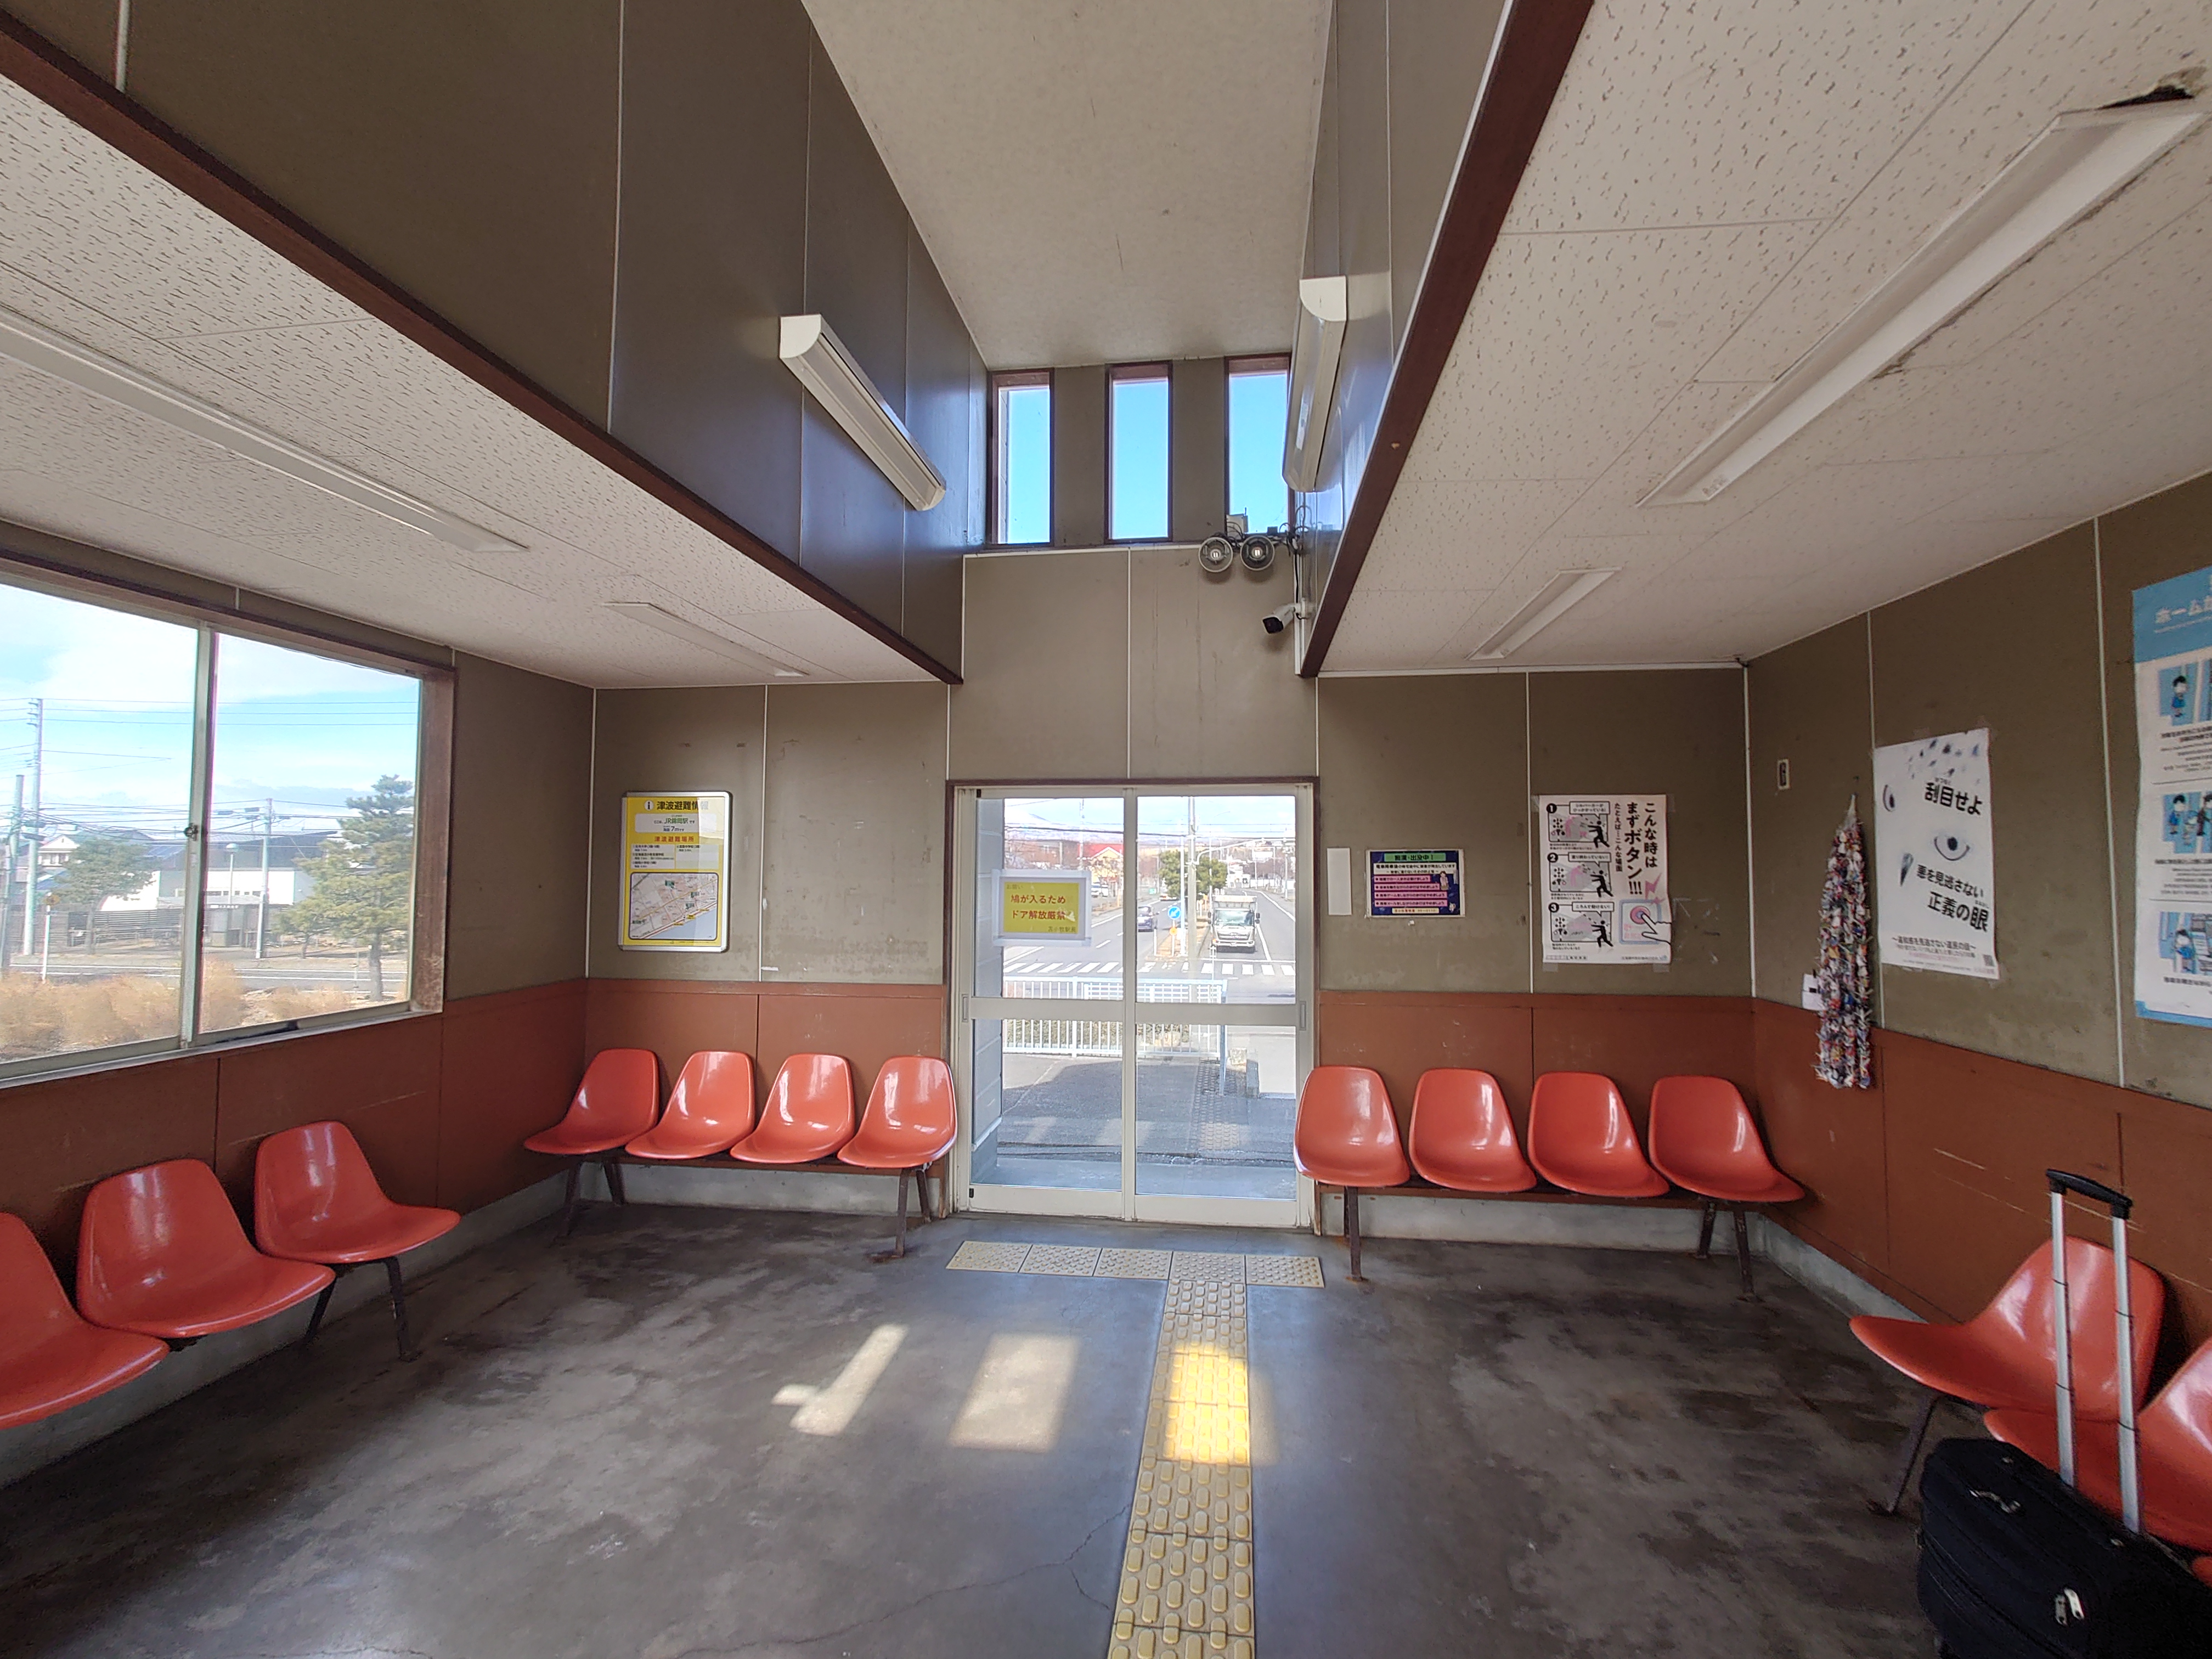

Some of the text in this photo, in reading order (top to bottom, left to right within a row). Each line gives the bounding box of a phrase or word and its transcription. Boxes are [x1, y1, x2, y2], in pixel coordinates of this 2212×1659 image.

[1925, 782, 1982, 815] 刮目せよ
[1644, 803, 1658, 868] こんな時は
[1917, 864, 1983, 898] 悪を見逃さない
[1011, 895, 1066, 904] 鳩が入るため
[1013, 910, 1066, 920] ドア解放厳禁
[1928, 891, 1989, 933] 正義の眼
